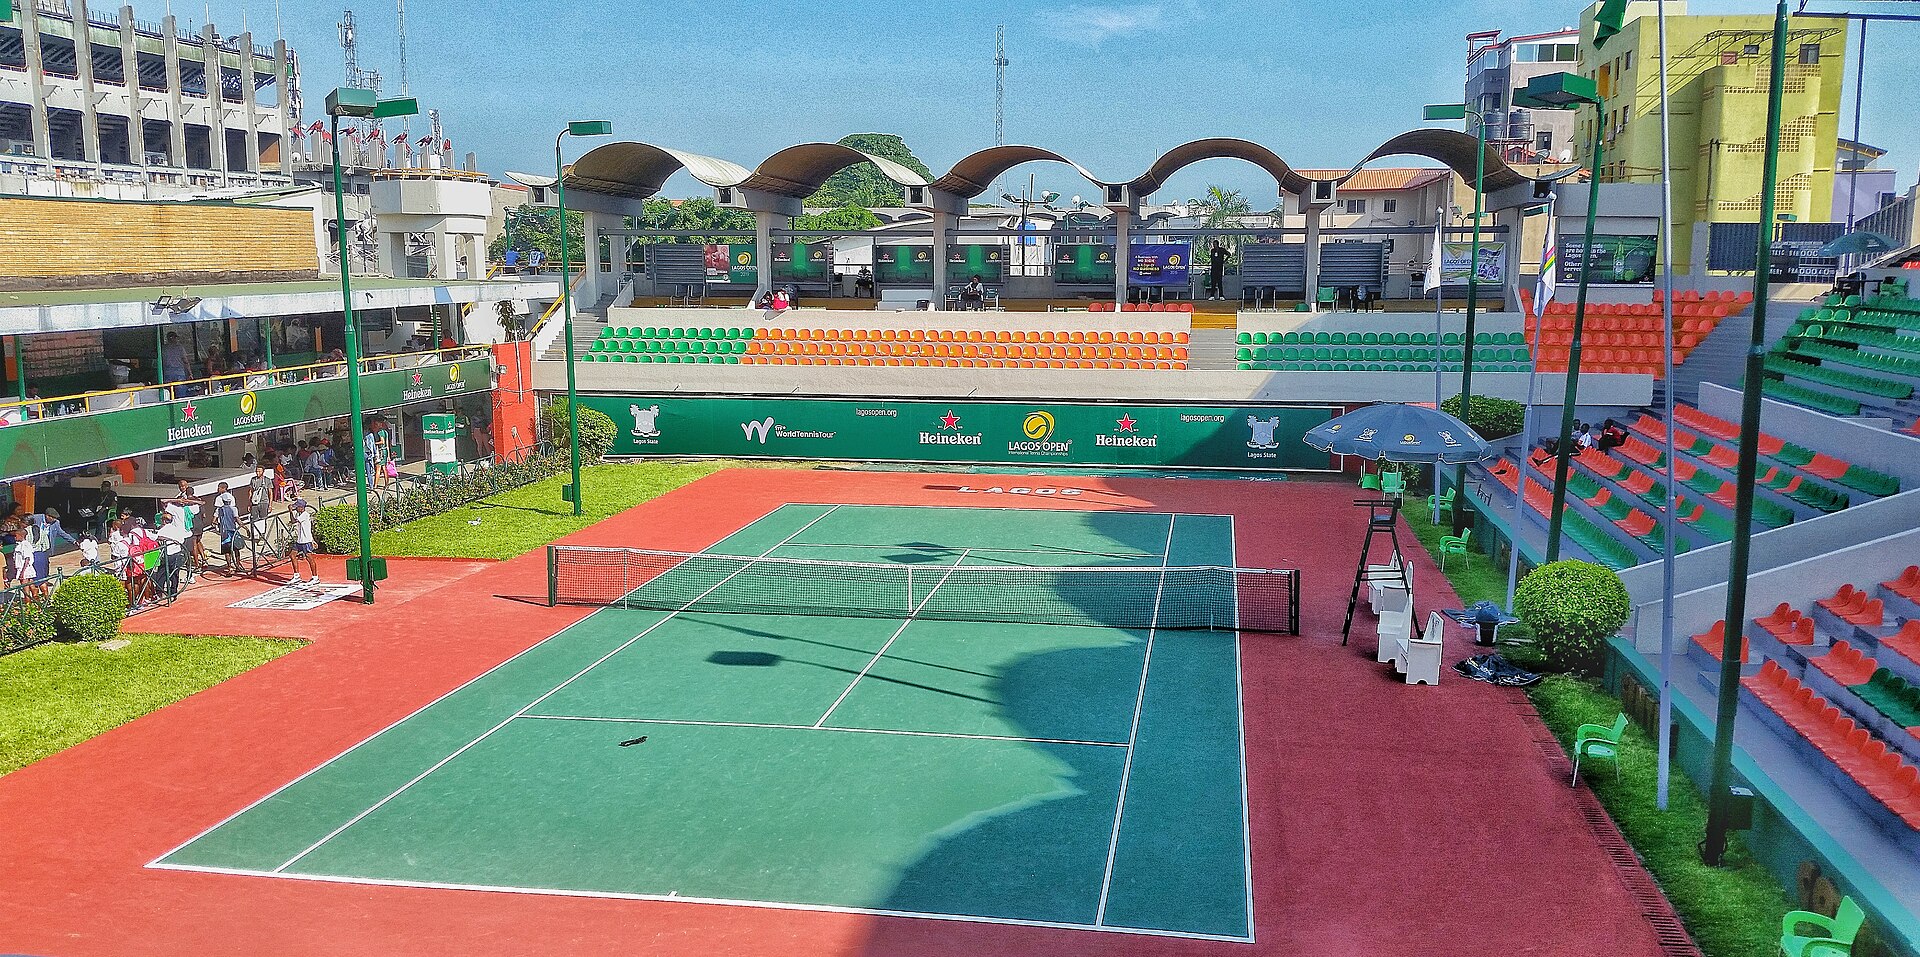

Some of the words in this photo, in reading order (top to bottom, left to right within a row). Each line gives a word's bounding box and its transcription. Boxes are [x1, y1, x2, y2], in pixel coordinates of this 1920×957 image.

[403, 387, 432, 401] Heineken
[856, 408, 897, 417] lagosopen.org
[1180, 413, 1225, 423] lagosopen.org
[233, 415, 251, 426] LAGOS
[251, 413, 264, 423] OPEN
[167, 423, 213, 442] Heineken
[920, 432, 982, 445] Heineken
[1008, 441, 1041, 451] LAGOS
[1042, 441, 1069, 452] OPEN
[1095, 434, 1157, 447] Heineken
[1247, 451, 1262, 459] Lagos
[957, 486, 1084, 496] LAGOS
